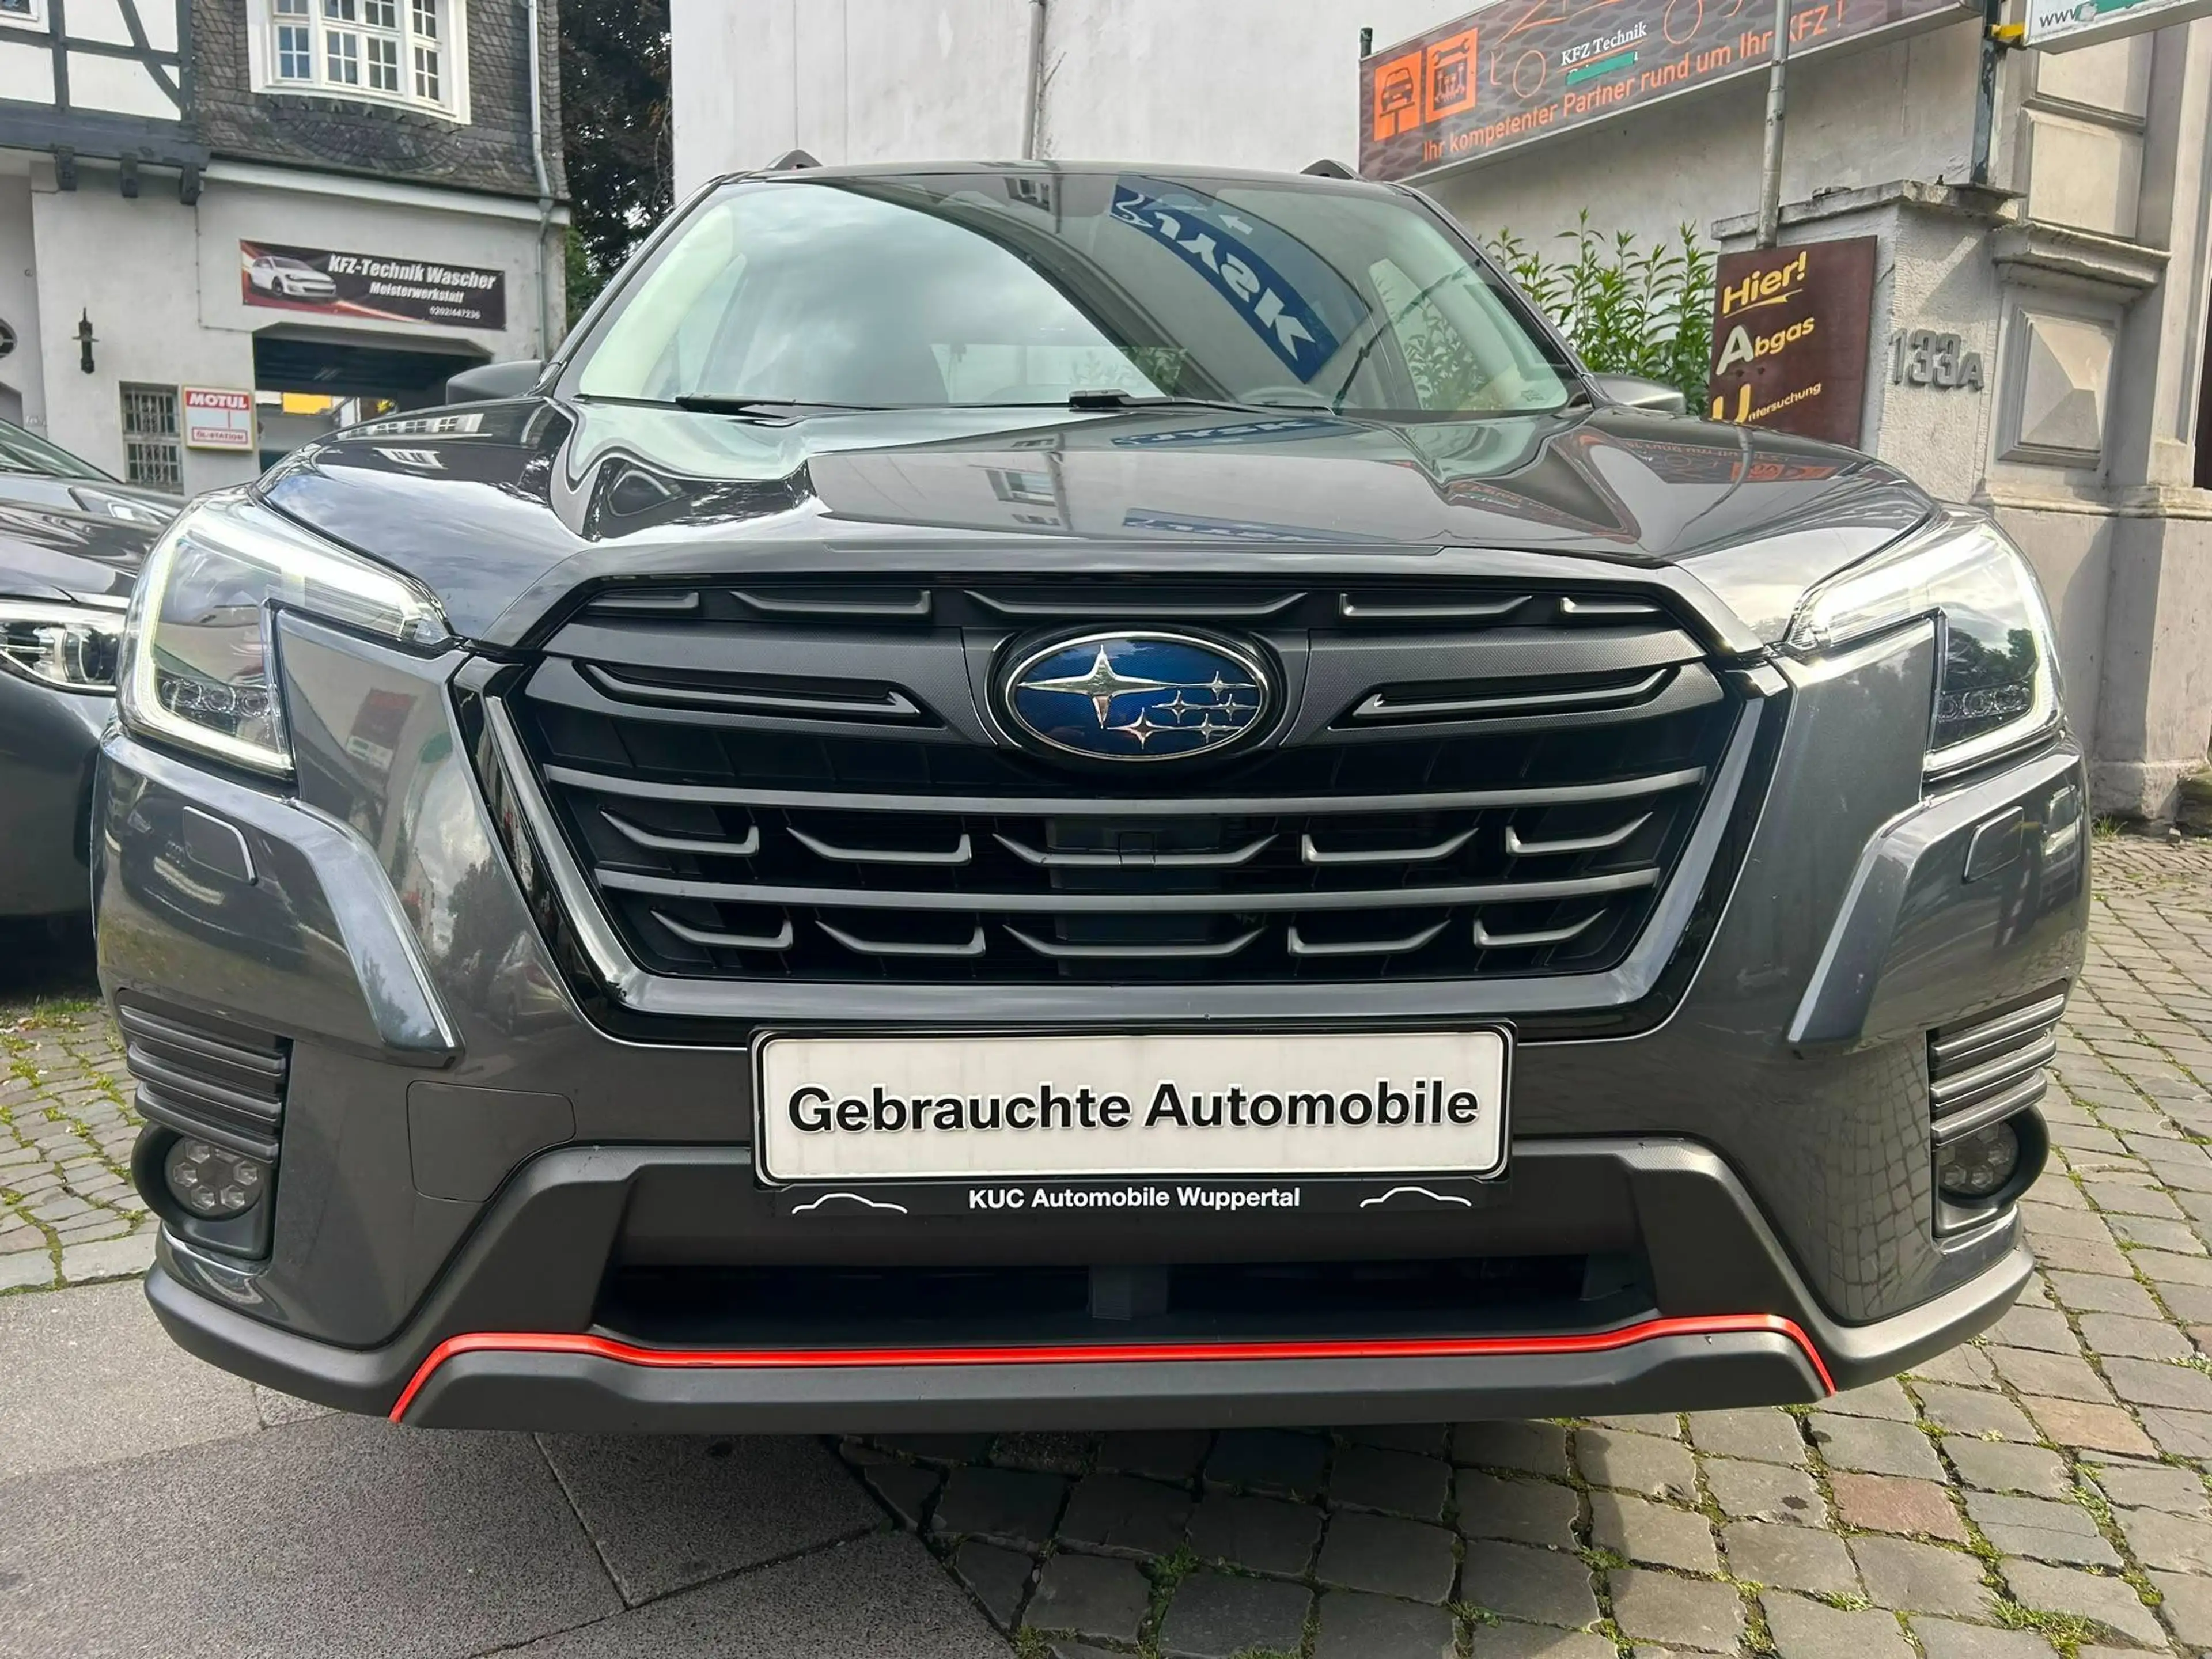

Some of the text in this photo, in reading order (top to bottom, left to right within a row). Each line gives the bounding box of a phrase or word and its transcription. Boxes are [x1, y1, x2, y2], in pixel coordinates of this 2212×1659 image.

[1560, 21, 1647, 66] KFZ Technik
[1423, 140, 1445, 162] Ihr
[1449, 103, 1558, 153] kompetenter
[1563, 77, 1635, 117] Partner
[1641, 52, 1690, 92] rund
[1696, 44, 1730, 73] um
[1740, 30, 1774, 59] Ihr
[328, 253, 497, 290] KFZ-Technik Wascher
[369, 281, 465, 304] Meisterwerkstatt
[1721, 250, 1807, 314] Hier!
[1715, 316, 1815, 376] Abgas
[1889, 327, 1985, 391] 133A
[189, 392, 247, 409] MOTUL
[787, 1079, 1479, 1132] Gebrauchte Automobile
[969, 1186, 1301, 1211] KUC Automobile Wuppertal
